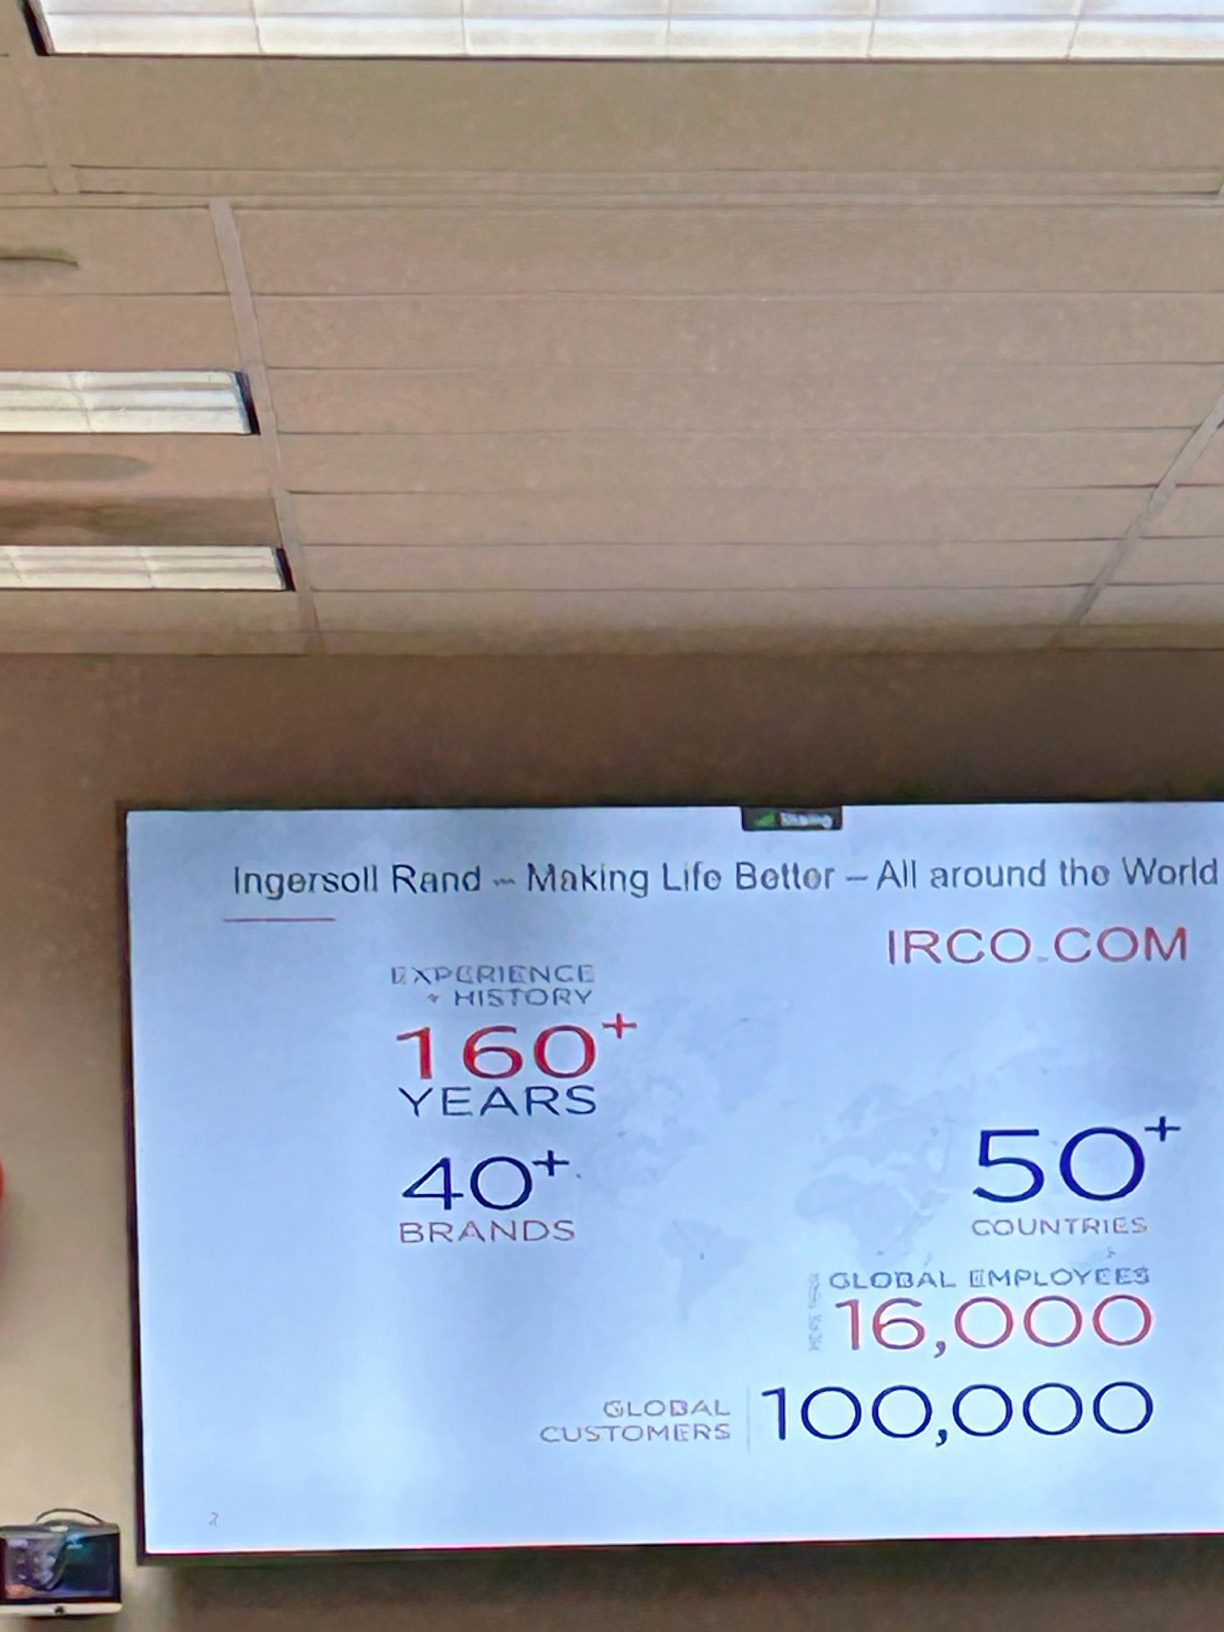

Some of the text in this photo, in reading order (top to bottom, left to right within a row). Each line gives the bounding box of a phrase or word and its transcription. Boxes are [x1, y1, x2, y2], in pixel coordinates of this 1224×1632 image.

[233, 864, 378, 900] Ingersoll
[392, 864, 481, 894] Rand
[526, 862, 650, 898] Making
[662, 860, 722, 891] Life
[735, 860, 835, 890] Better
[876, 859, 917, 891] All
[930, 858, 1046, 889] around
[1059, 857, 1110, 887] the
[1122, 855, 1219, 887] World
[887, 925, 1188, 965] IRCO.COM
[391, 964, 596, 985] EXPERIENCE
[454, 987, 593, 1007] HISTORY
[398, 1085, 597, 1117] YEARS
[399, 1219, 576, 1243] BRANDS
[971, 1216, 1148, 1236] COUNTRIES
[829, 1266, 1151, 1290] GLOBAL EMPLOYEES
[835, 1293, 1153, 1358] 16,000
[602, 1399, 731, 1418] GLOBAL
[761, 1381, 1154, 1447] 100,000
[539, 1423, 731, 1443] CUSTOMERS
